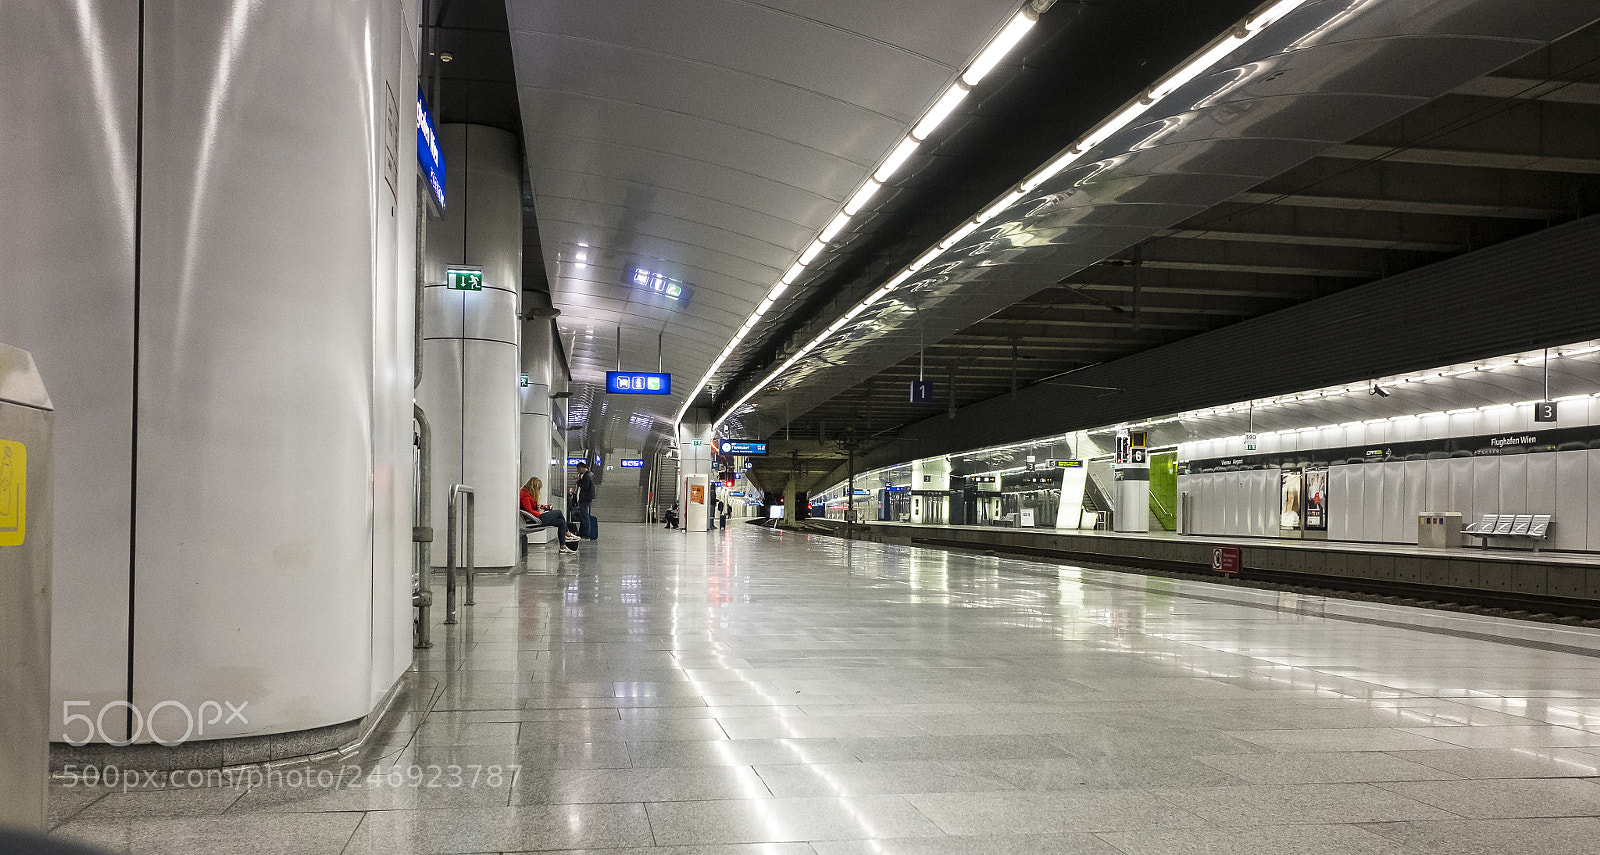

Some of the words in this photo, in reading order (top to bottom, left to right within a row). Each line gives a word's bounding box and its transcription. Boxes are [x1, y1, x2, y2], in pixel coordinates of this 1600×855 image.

[919, 384, 925, 399] 1
[1544, 405, 1552, 418] 3
[1491, 437, 1519, 447] Flughafen
[1520, 436, 1536, 444] Wien
[1135, 451, 1142, 461] 6
